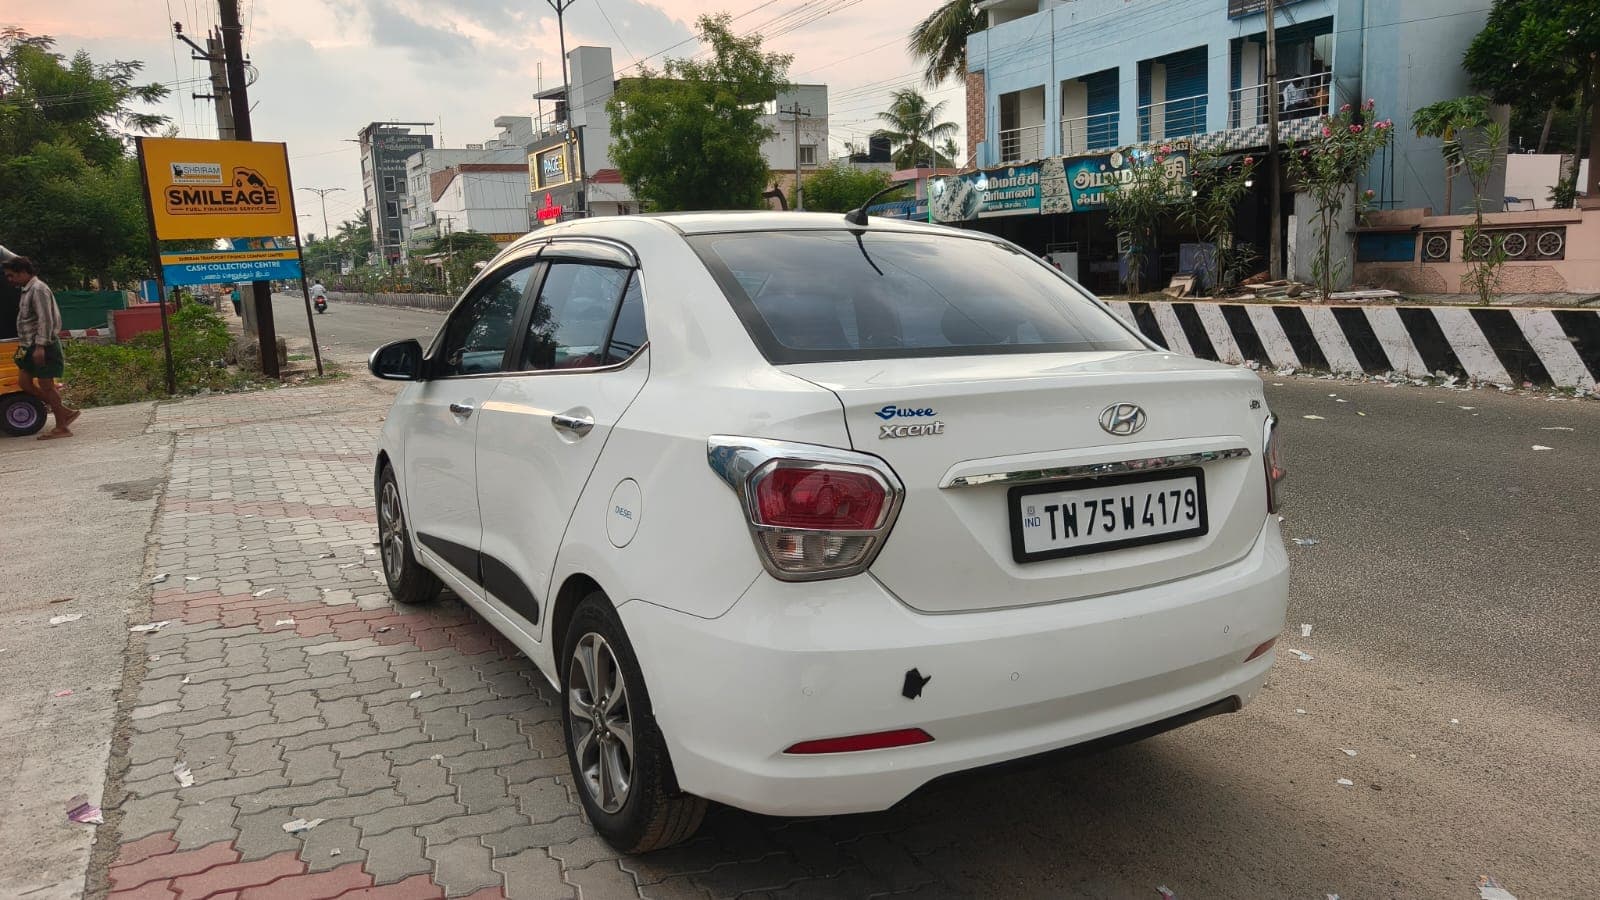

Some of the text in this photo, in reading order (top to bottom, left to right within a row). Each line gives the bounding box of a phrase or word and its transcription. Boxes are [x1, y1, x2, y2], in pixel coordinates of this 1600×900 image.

[183, 165, 220, 175] SHRIRAM
[169, 190, 277, 205] SMILEAGE
[208, 263, 253, 272] COLLECTION
[254, 261, 281, 269] CENTRE
[874, 405, 938, 421] Susee
[615, 505, 633, 520] DIESEL
[1024, 516, 1041, 528] IND
